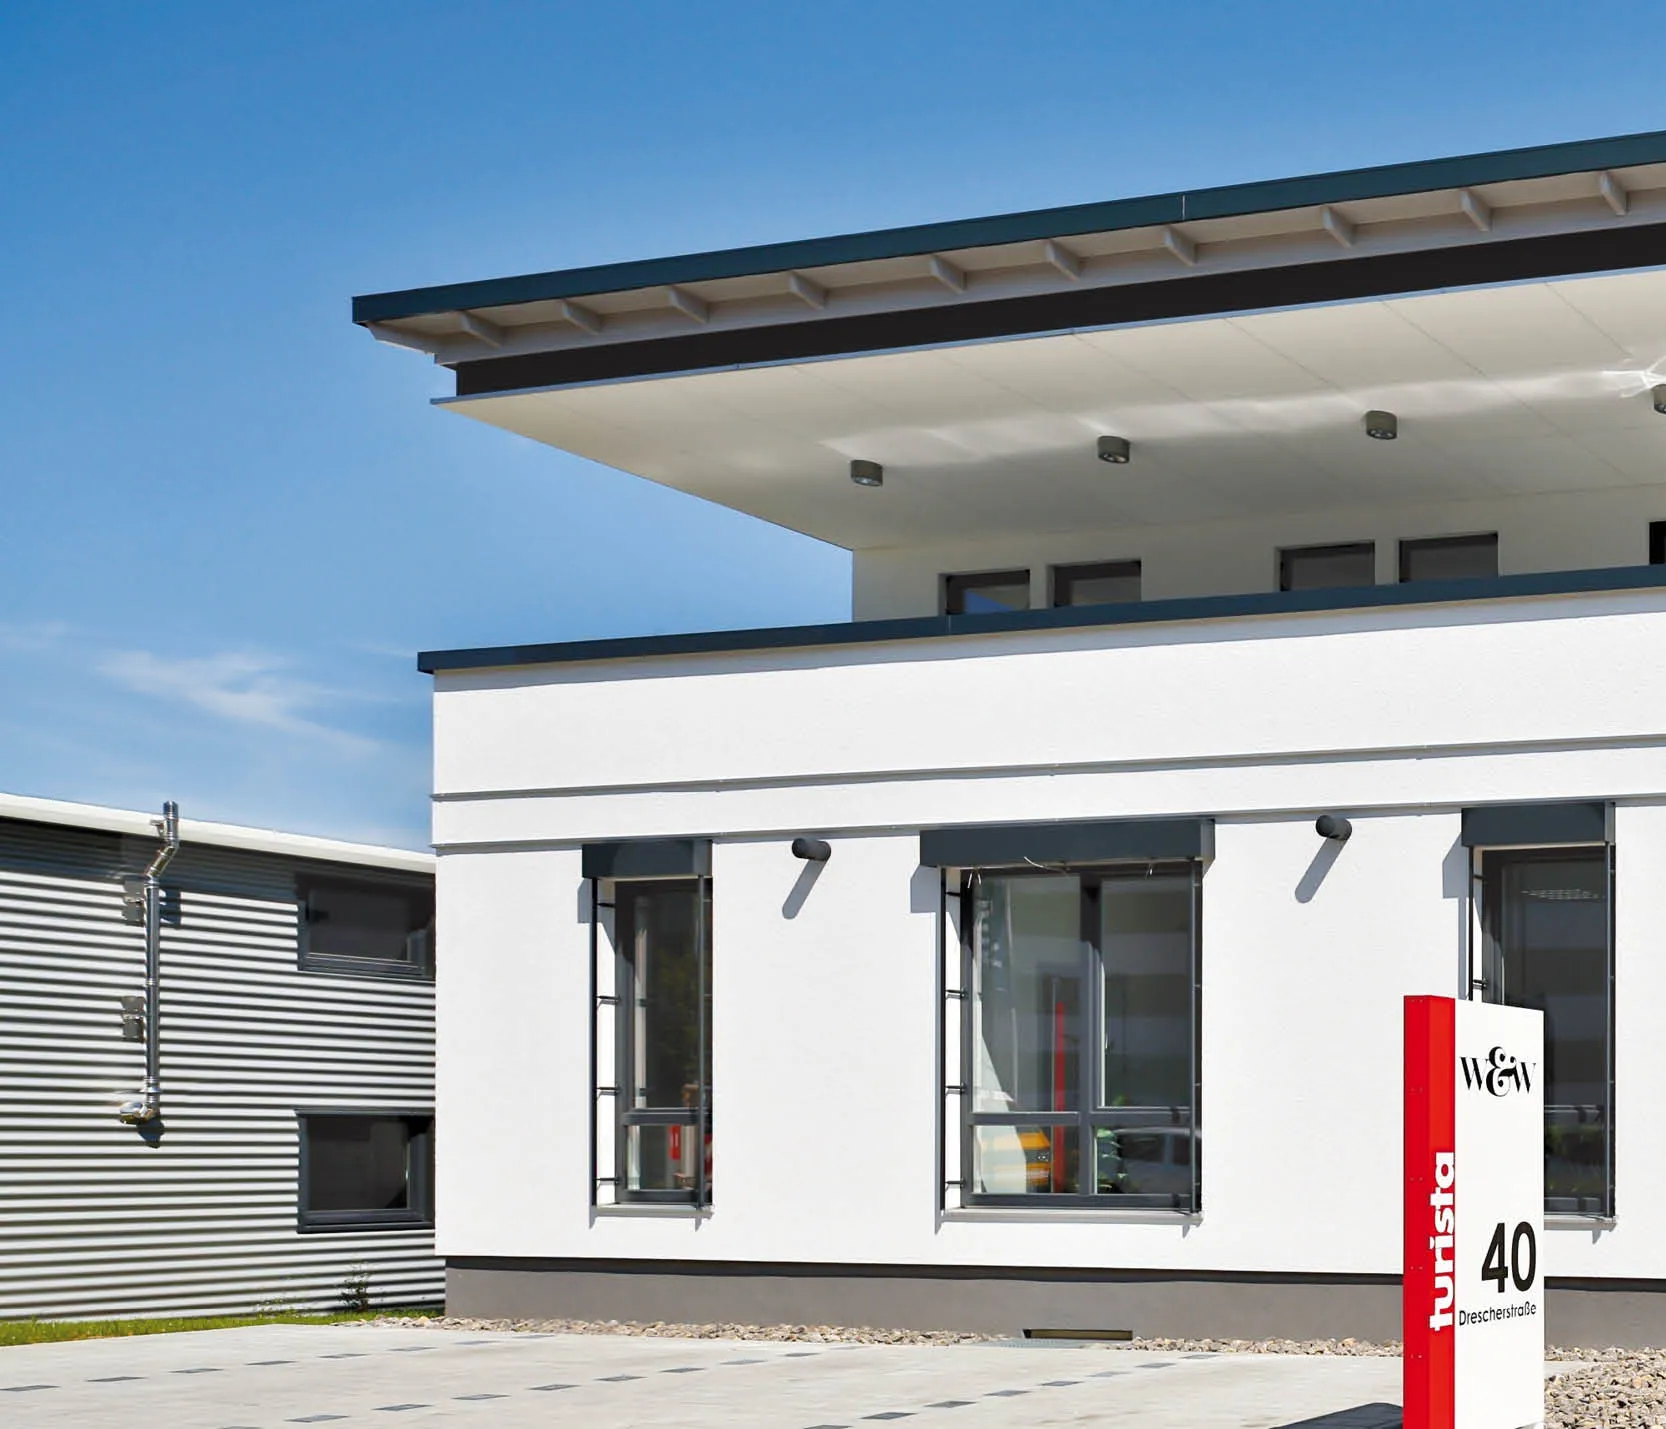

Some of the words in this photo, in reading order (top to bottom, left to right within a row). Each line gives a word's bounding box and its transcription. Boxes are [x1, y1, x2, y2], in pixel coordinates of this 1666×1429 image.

[1459, 1046, 1537, 1097] W&W
[1429, 1152, 1455, 1332] turista
[1481, 1221, 1537, 1294] 40
[1458, 1300, 1537, 1326] Drescherstraße
